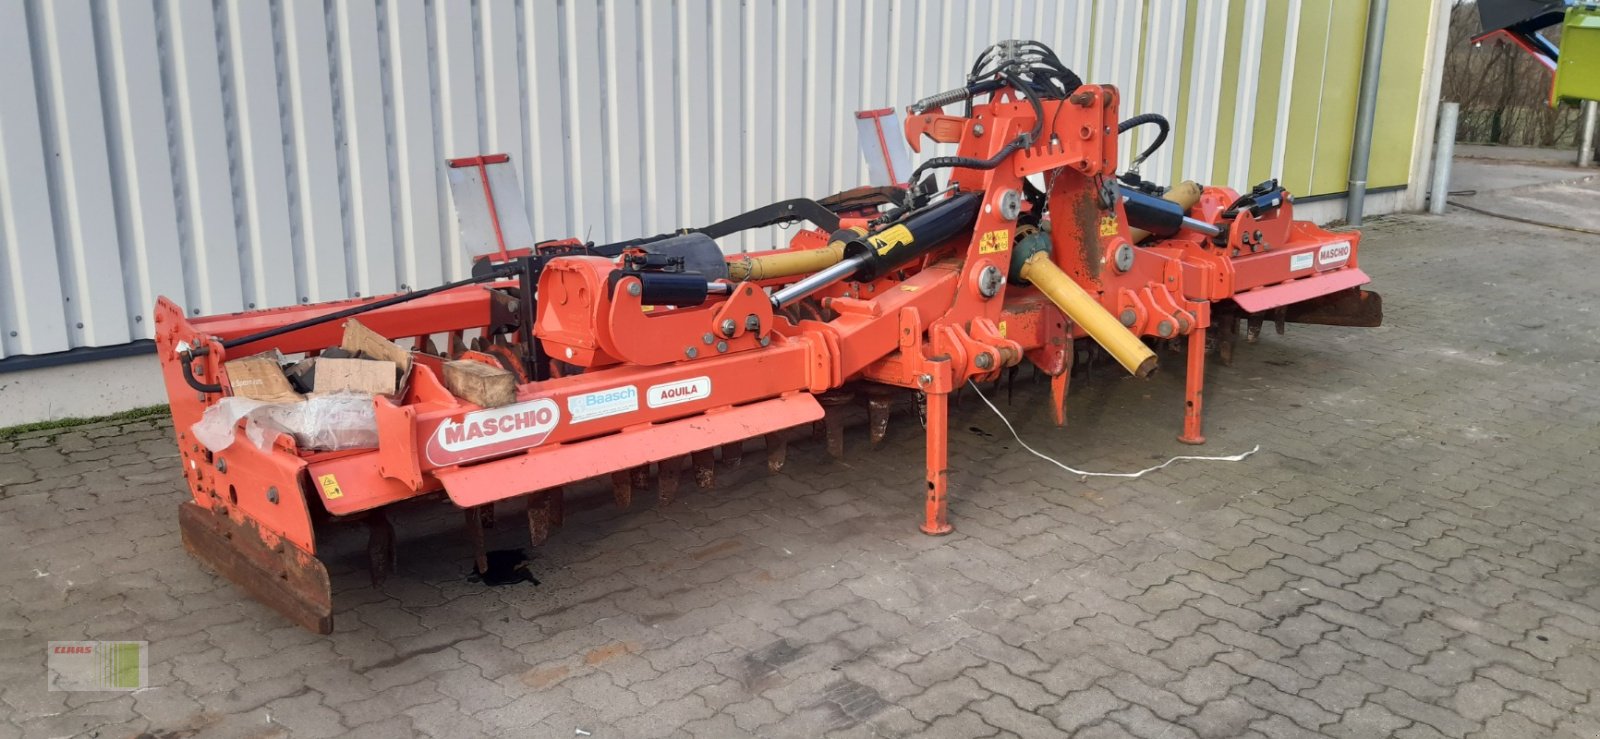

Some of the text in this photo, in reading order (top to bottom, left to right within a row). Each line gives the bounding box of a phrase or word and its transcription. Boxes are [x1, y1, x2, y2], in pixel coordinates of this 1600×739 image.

[1320, 246, 1349, 260] MASCHIO
[586, 387, 635, 407] Baasch
[661, 385, 698, 400] AQUILA
[445, 407, 552, 444] MASCHIO
